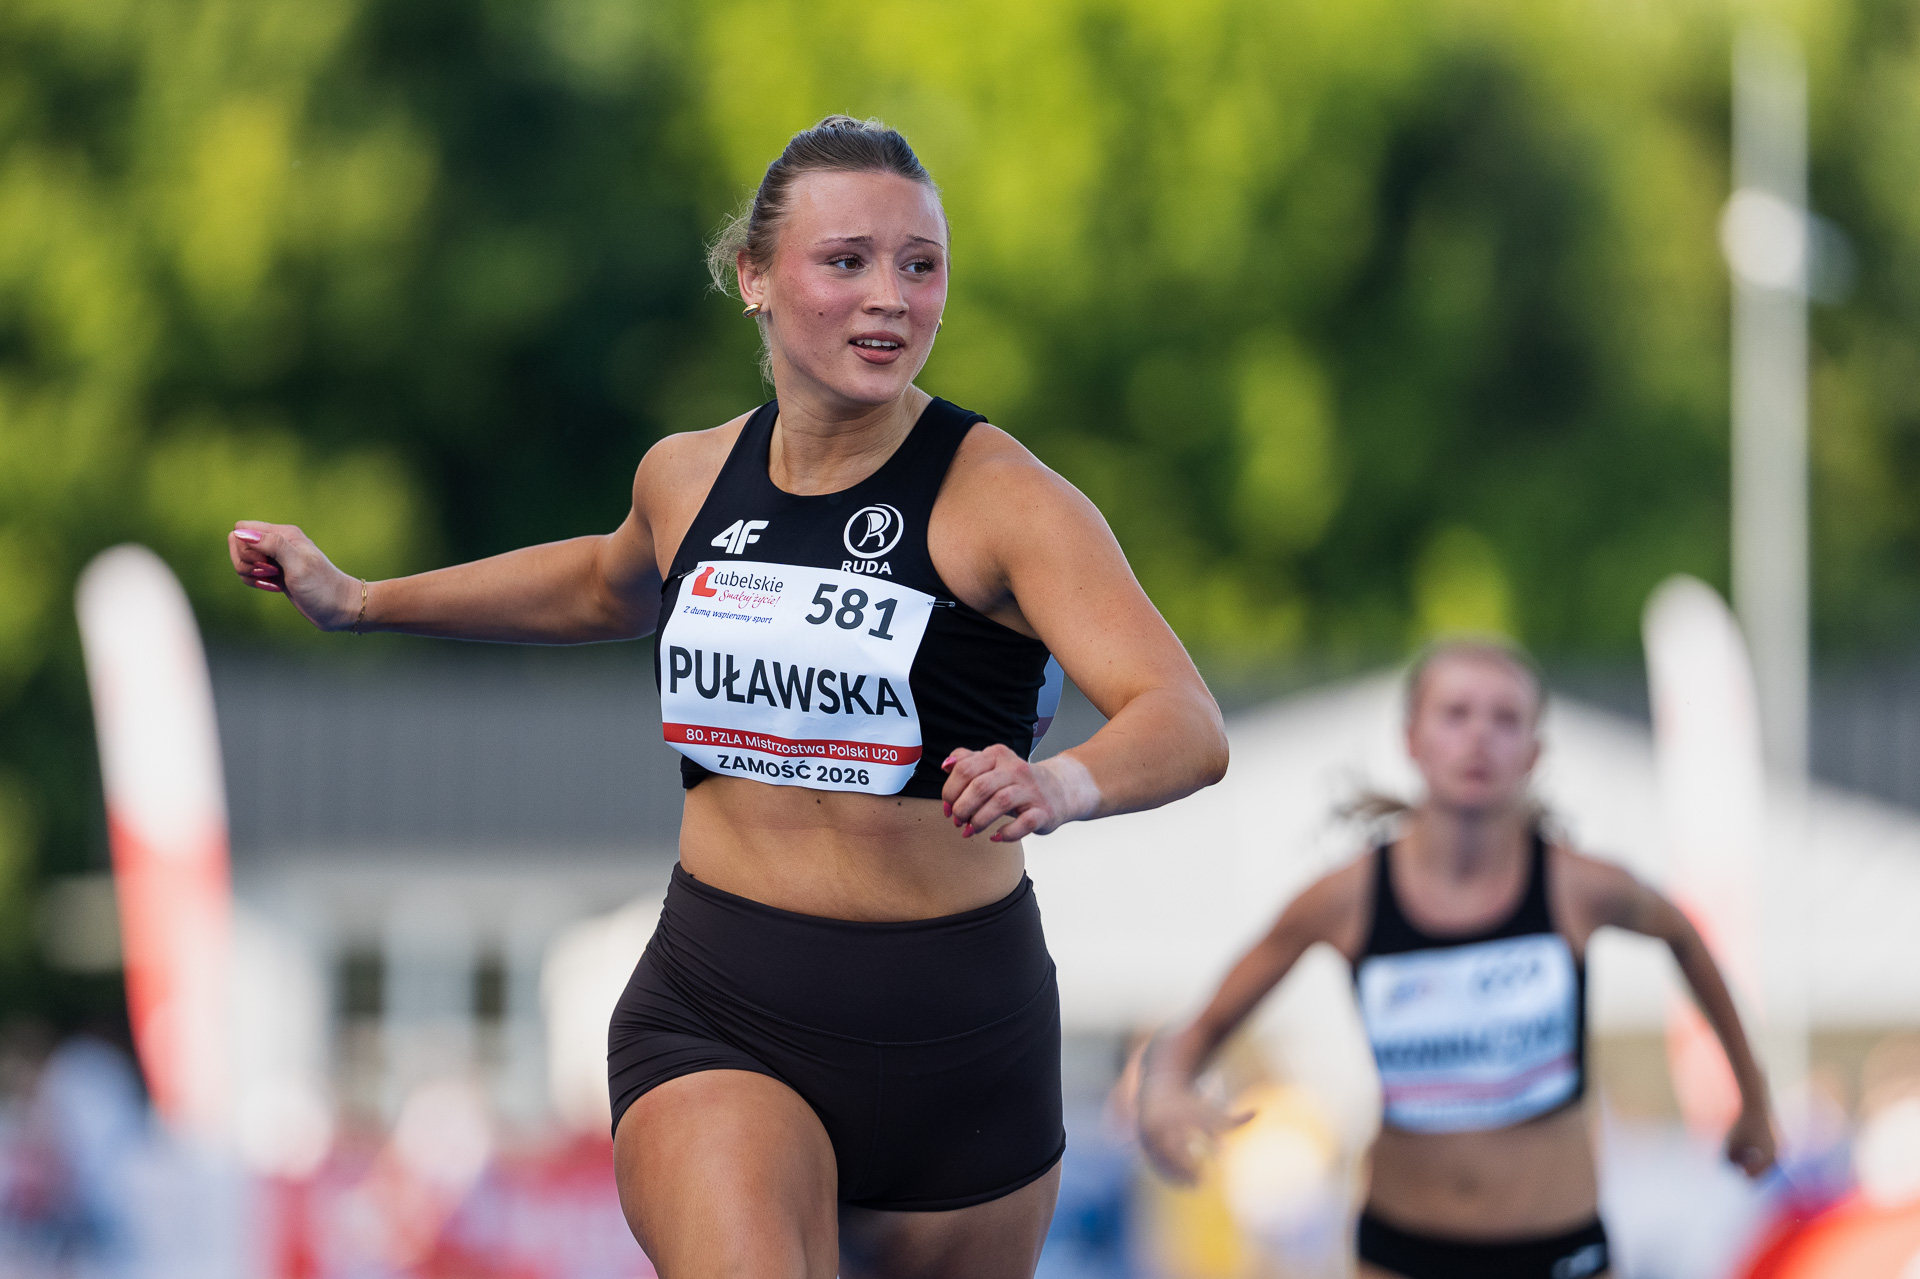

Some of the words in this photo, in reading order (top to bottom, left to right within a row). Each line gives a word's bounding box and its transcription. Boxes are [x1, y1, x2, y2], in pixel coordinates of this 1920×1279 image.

[711, 519, 769, 554] 4F
[841, 560, 892, 575] RUDA
[690, 607, 711, 617] dumą
[712, 610, 752, 623] wspieramy
[752, 615, 773, 624] sport
[805, 583, 898, 641] 581
[669, 645, 909, 718] PUŁAWSKA
[685, 728, 708, 742] 80.
[711, 731, 743, 745] PZLA
[745, 735, 826, 755] Mistrzostwa
[829, 744, 869, 759] Polski
[872, 748, 898, 762] U20
[717, 754, 812, 779] ZAMOŚĆ
[816, 765, 870, 786] 2026
